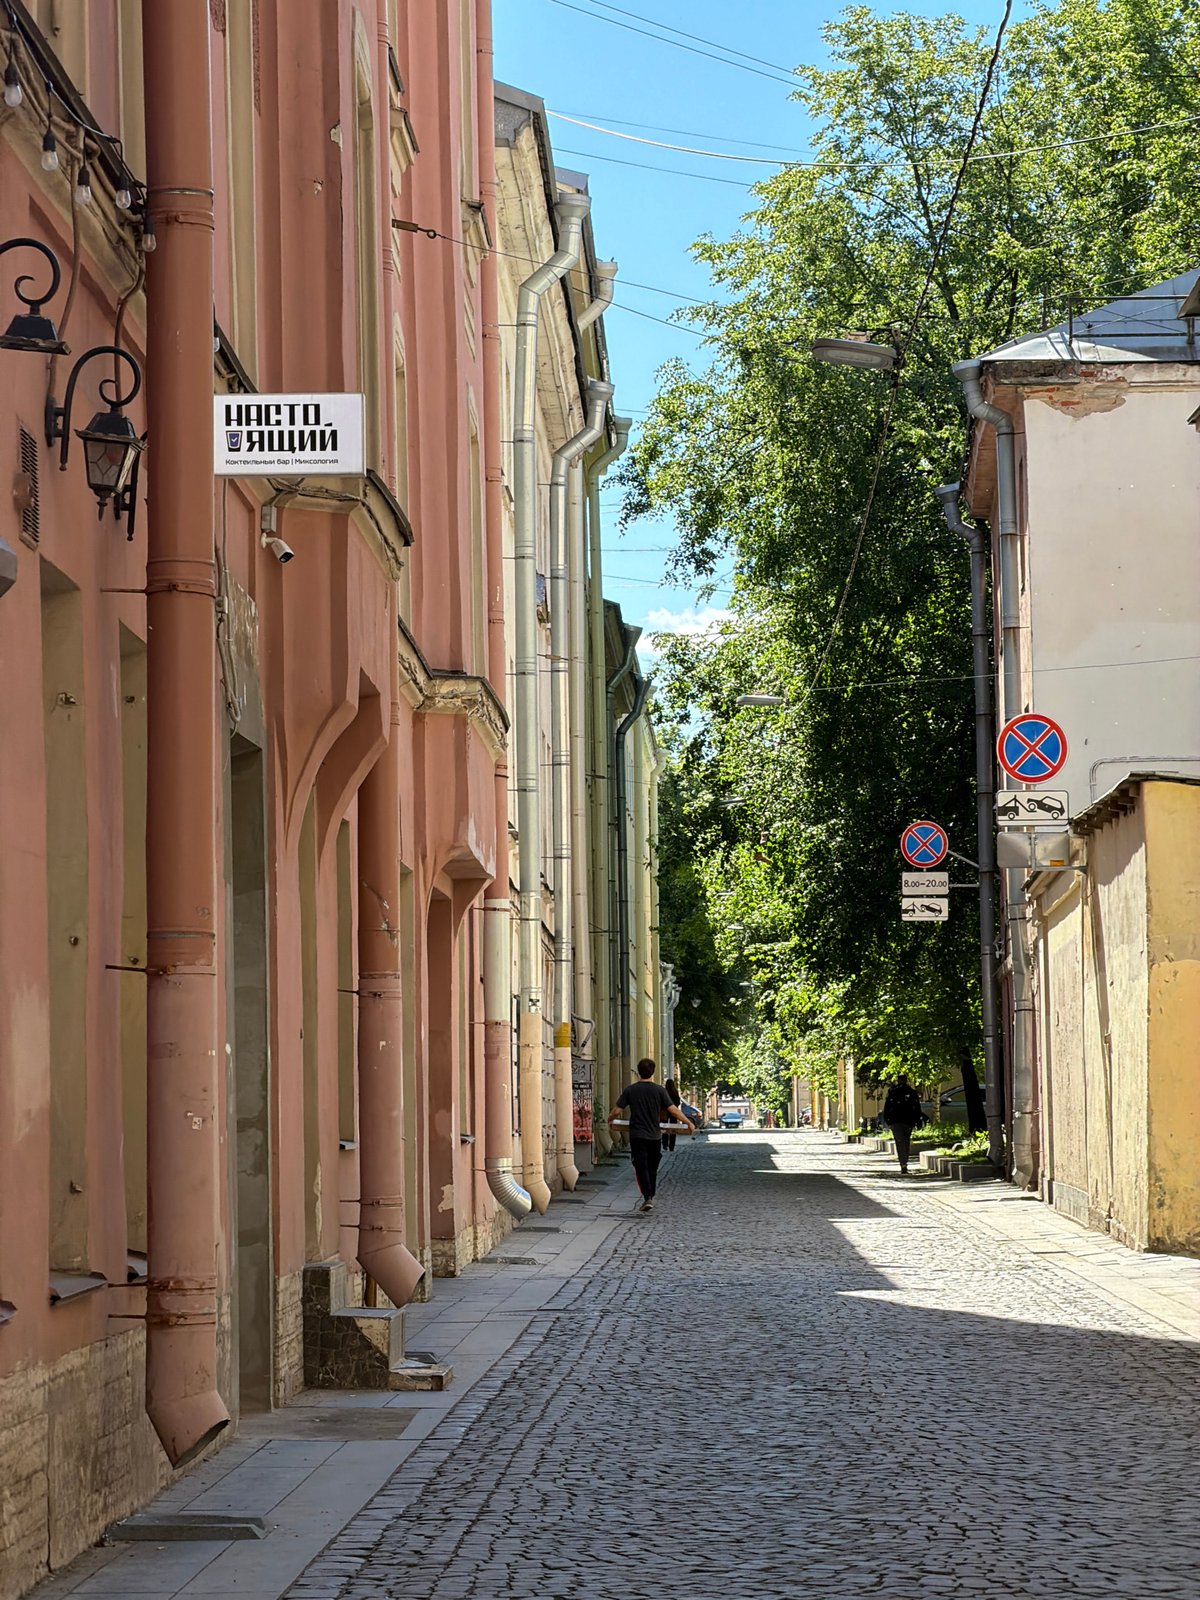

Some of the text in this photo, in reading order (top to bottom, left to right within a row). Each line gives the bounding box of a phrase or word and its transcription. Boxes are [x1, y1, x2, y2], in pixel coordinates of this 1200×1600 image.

[225, 404, 320, 426] НАСТО
[246, 422, 338, 453] ЯЩИЙ
[276, 458, 290, 466] бар
